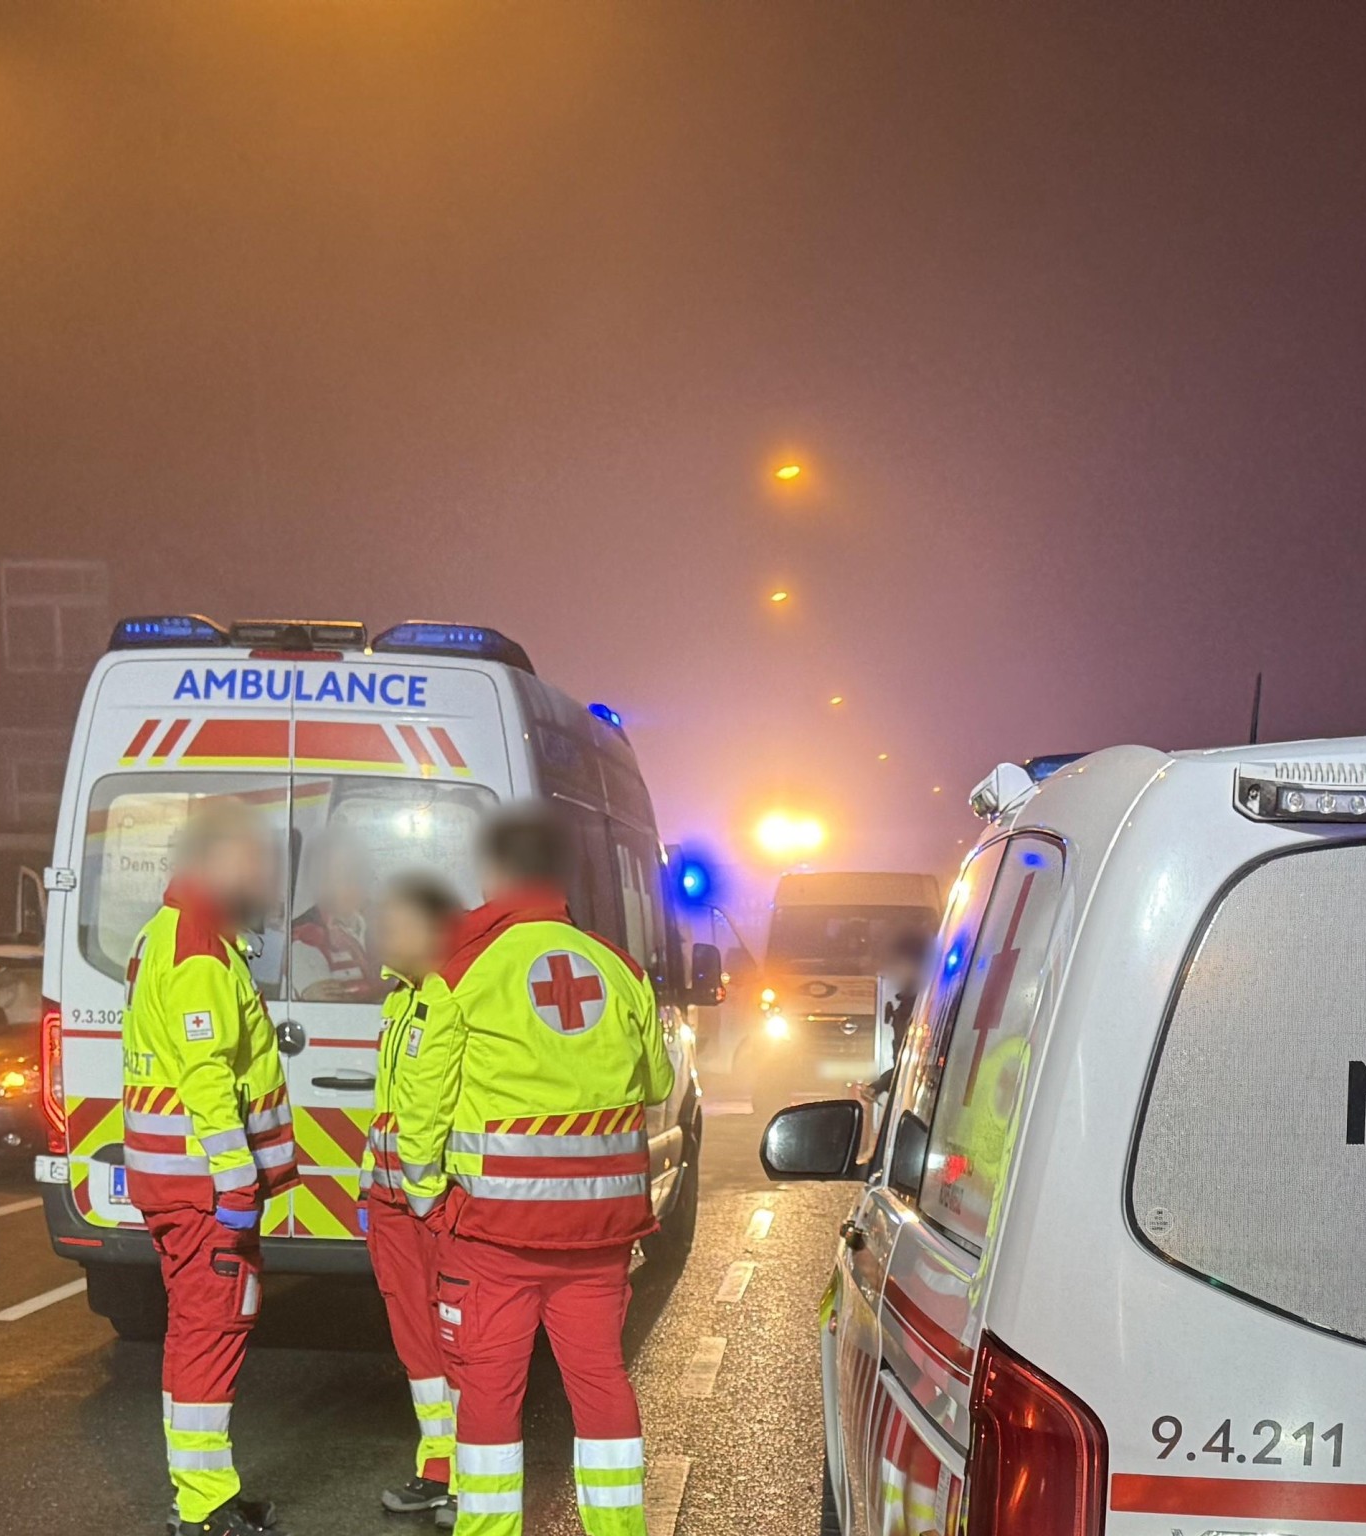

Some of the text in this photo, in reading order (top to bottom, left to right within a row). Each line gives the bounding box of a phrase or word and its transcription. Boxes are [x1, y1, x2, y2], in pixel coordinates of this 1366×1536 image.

[173, 667, 428, 707] AMBULANCE
[120, 856, 155, 872] Dem
[1151, 1414, 1344, 1468] 9.4.211
